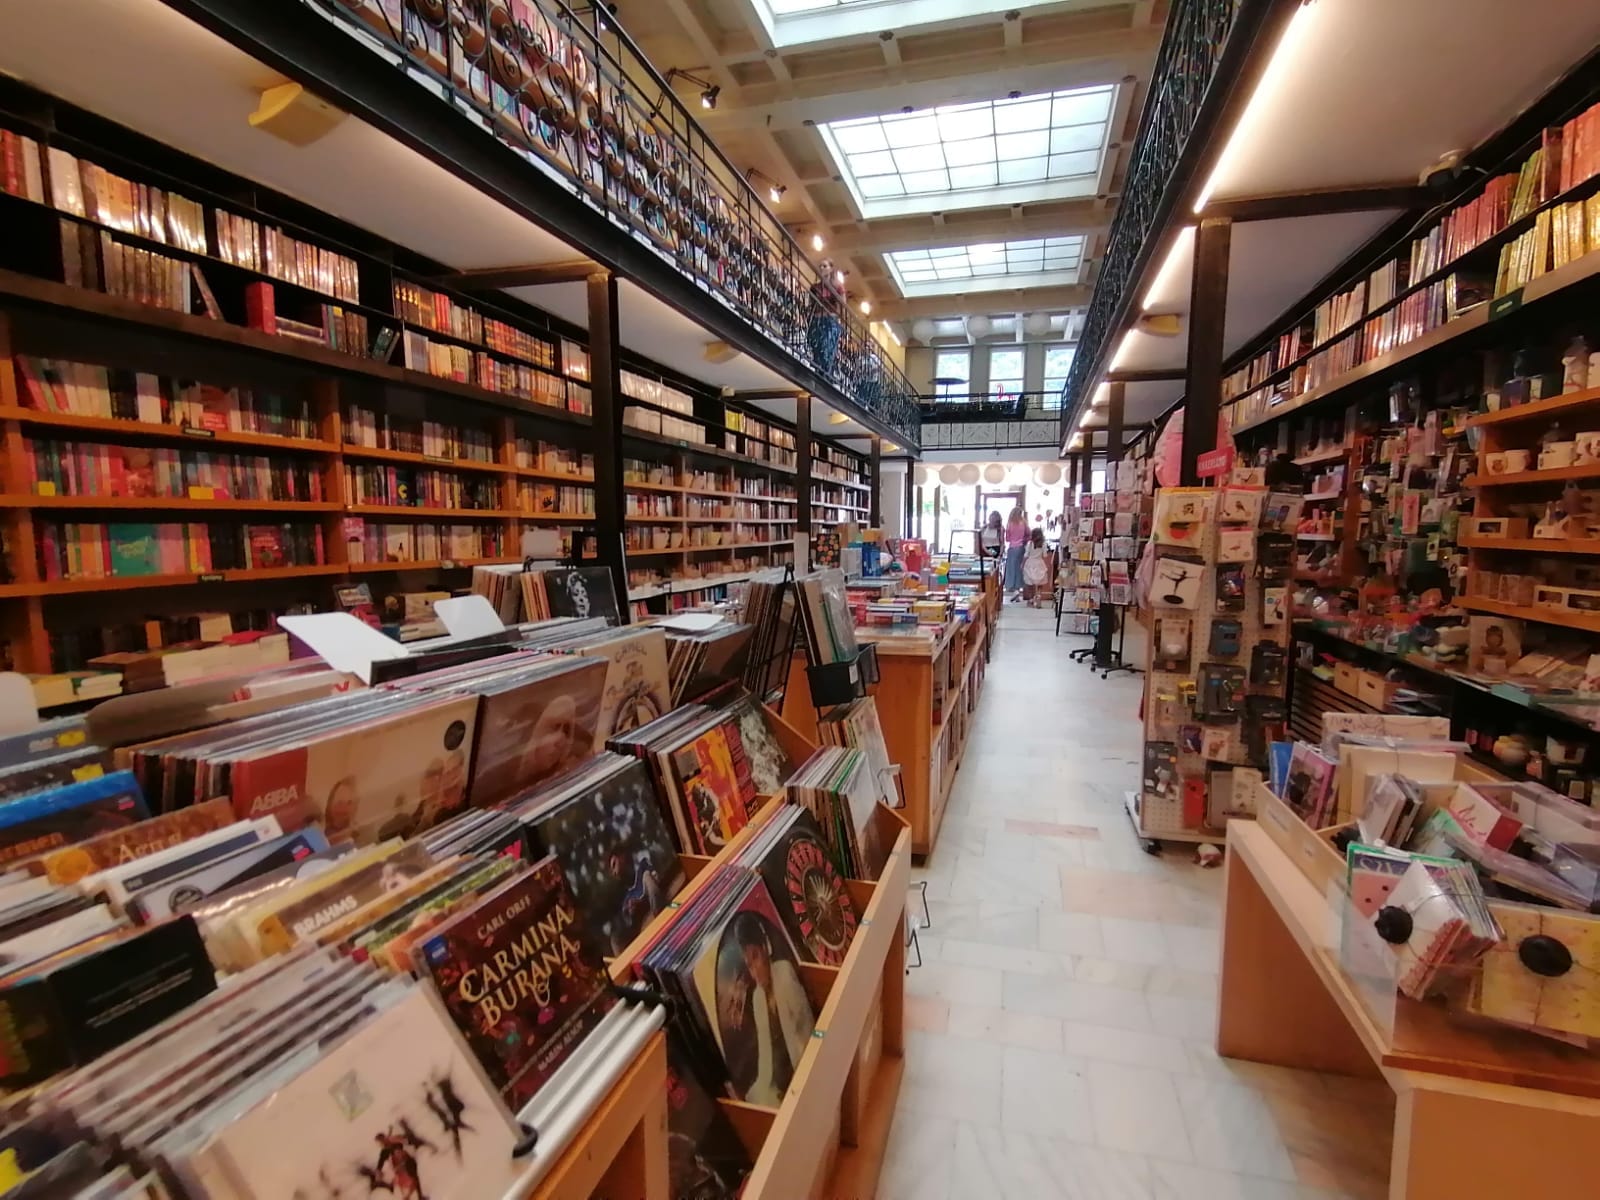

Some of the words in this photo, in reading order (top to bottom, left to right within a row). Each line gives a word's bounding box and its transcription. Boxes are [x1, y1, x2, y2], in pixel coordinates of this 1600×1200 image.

[249, 784, 299, 815] ABBA
[293, 895, 358, 937] BRAHMS
[476, 915, 505, 940] CARL
[505, 895, 532, 920] ORFF
[459, 905, 574, 1002] CARMINA
[478, 936, 581, 1029] BURANA
